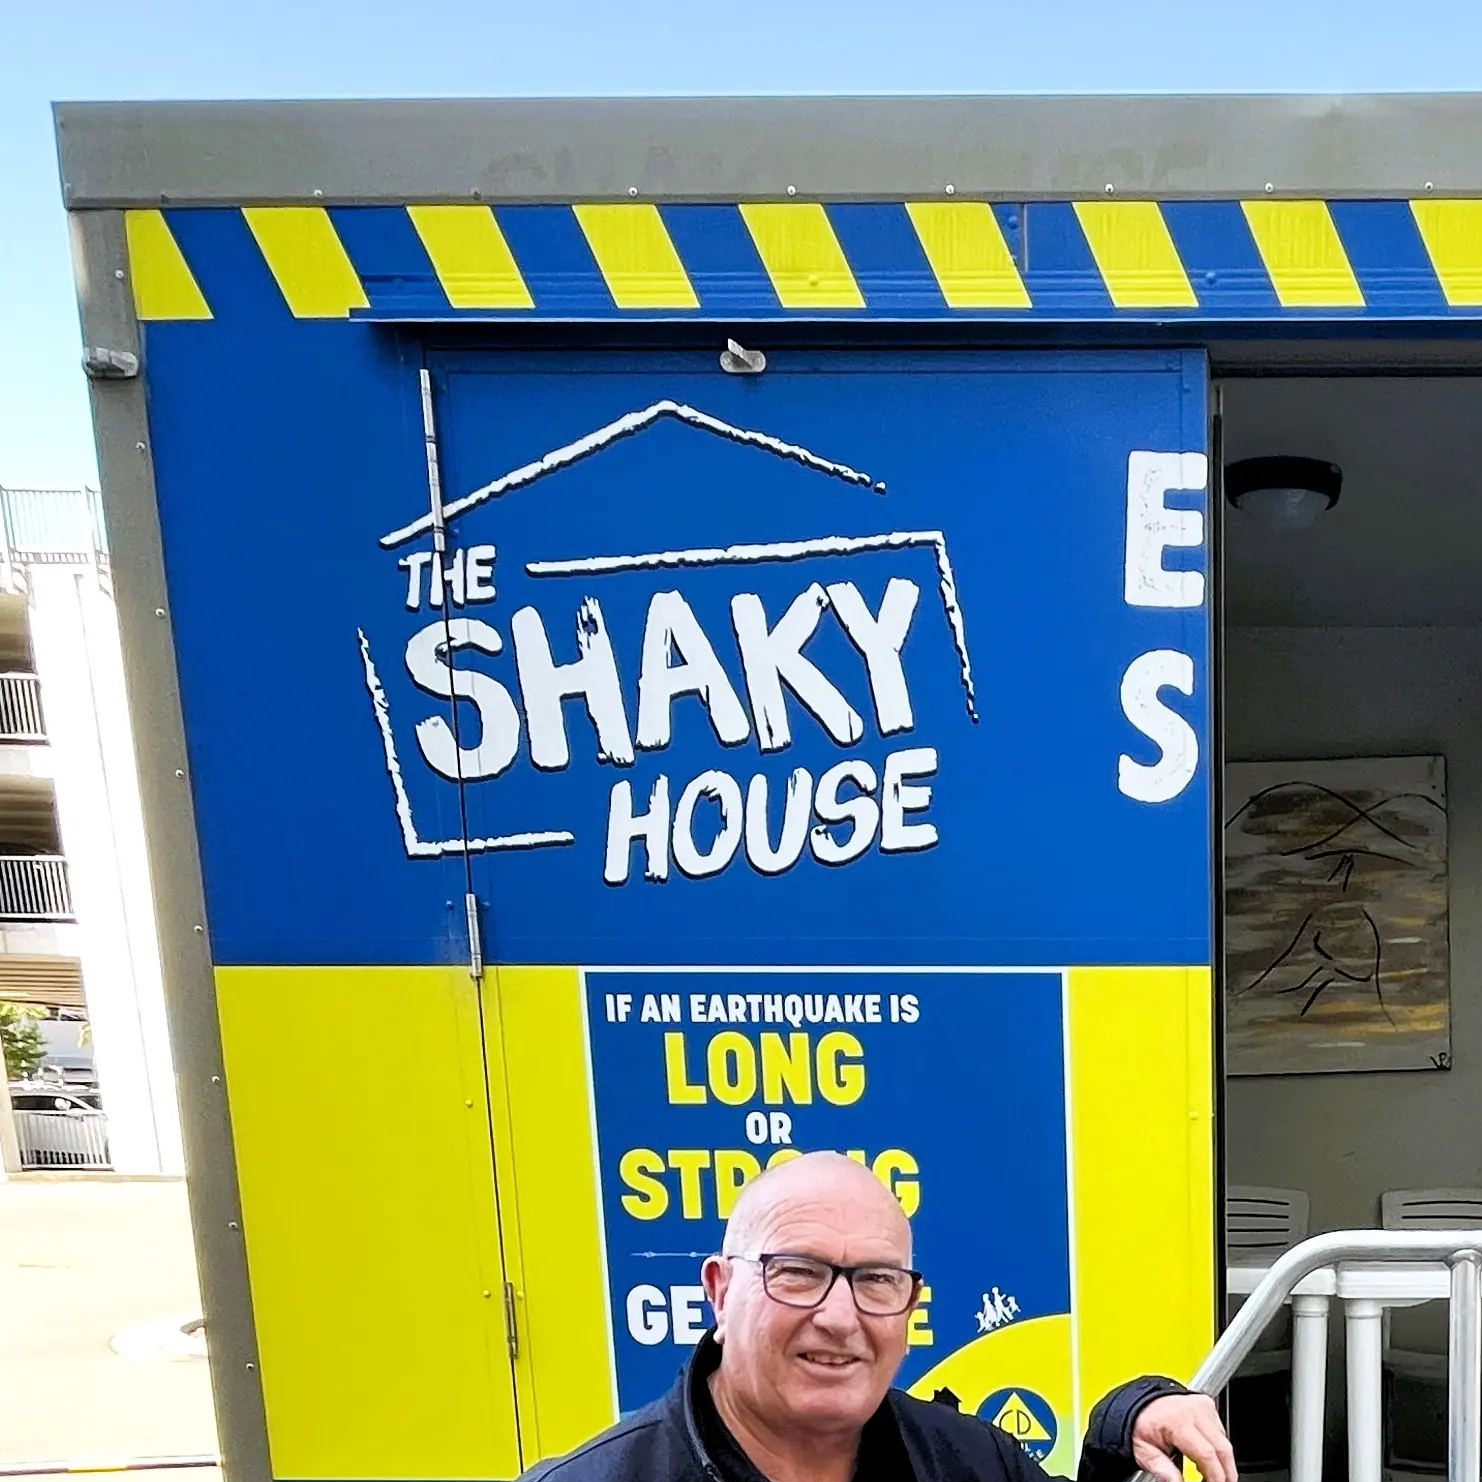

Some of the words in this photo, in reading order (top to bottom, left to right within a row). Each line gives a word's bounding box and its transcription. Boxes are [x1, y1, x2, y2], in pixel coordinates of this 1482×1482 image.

[399, 544, 497, 609] THE
[404, 577, 920, 782] SHAKY
[603, 747, 939, 885] HOUSE
[605, 994, 632, 1023] IF
[640, 994, 682, 1023] AN
[690, 994, 882, 1028] EARTHQUAKE
[890, 994, 920, 1023] IS
[664, 1031, 867, 1106] LONG
[745, 1111, 792, 1145] OR
[618, 1149, 921, 1221] STRG
[999, 1409, 1032, 1436] CD
